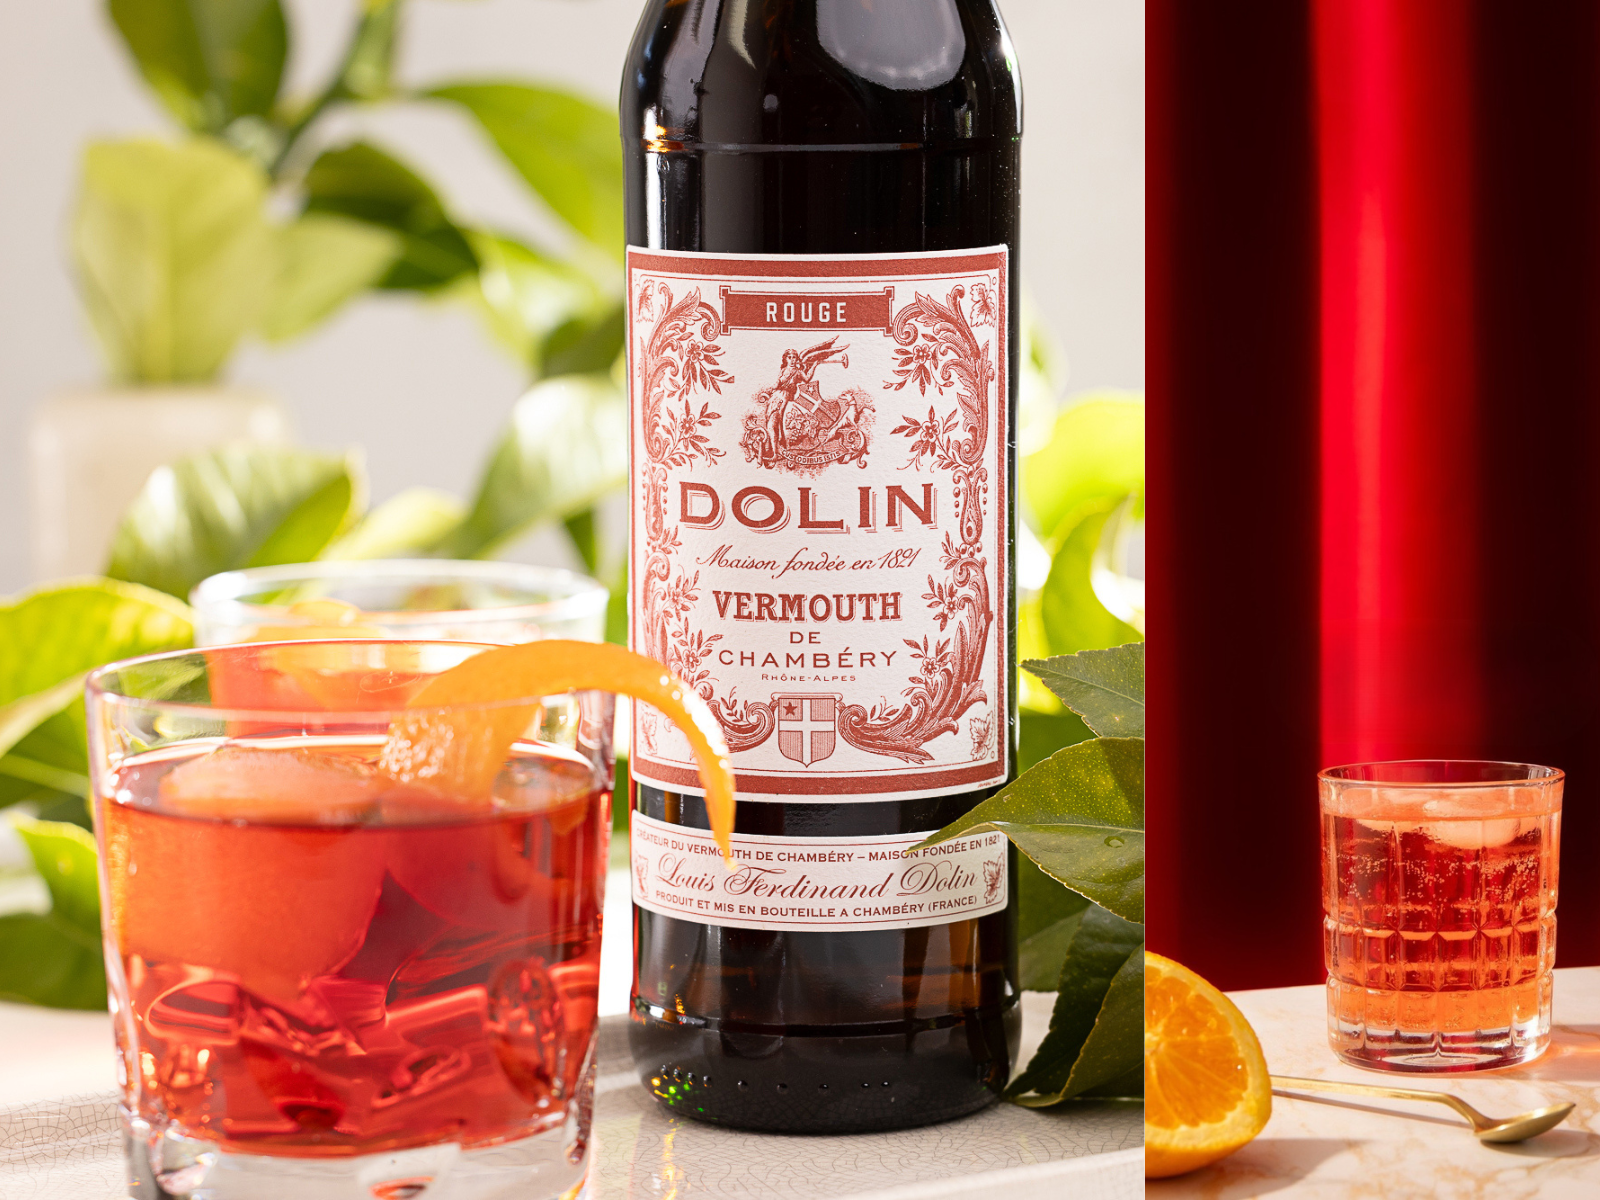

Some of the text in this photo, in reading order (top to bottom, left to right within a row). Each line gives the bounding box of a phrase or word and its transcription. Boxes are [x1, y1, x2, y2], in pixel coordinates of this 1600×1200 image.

[766, 302, 847, 323] ROUGE
[679, 481, 938, 535] DOLIN
[696, 544, 781, 571] Maison
[772, 547, 845, 579] fondée
[852, 559, 874, 570] en
[713, 590, 903, 623] VERMOUTH
[790, 632, 820, 645] DE
[718, 647, 897, 669] CHAMBÉRY
[636, 827, 669, 848] CRÉATEUR
[671, 840, 684, 851] DU
[756, 851, 773, 861] DE
[777, 850, 854, 863] CHAMBÉRY
[869, 849, 919, 862] MAISON
[923, 842, 967, 858] FONDÉE
[970, 840, 982, 850] EN
[985, 834, 1000, 846] 1821
[655, 852, 978, 899] Louis Ferdinand Dolin
[656, 890, 977, 917] PRODUIT ET MIS EN BOUTEILLE A CHAMBÉRY (FRANCE)
